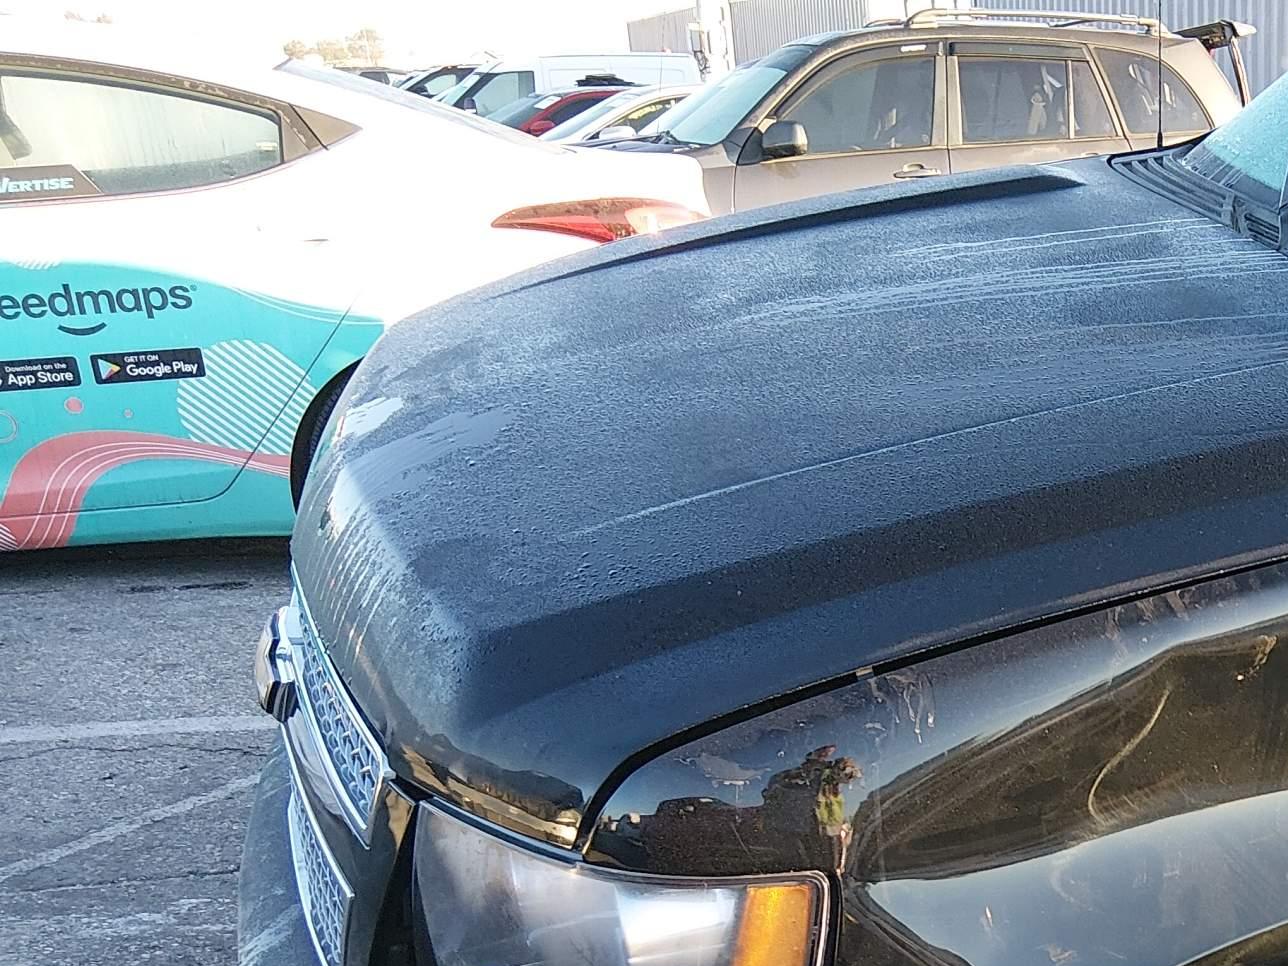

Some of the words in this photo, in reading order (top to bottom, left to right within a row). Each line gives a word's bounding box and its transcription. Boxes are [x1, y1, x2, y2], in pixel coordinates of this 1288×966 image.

[147, 354, 159, 362] ON
[4, 364, 42, 373] Download
[126, 362, 172, 377] Google
[172, 361, 198, 375] Play
[7, 373, 36, 387] App
[36, 371, 74, 383] Store
